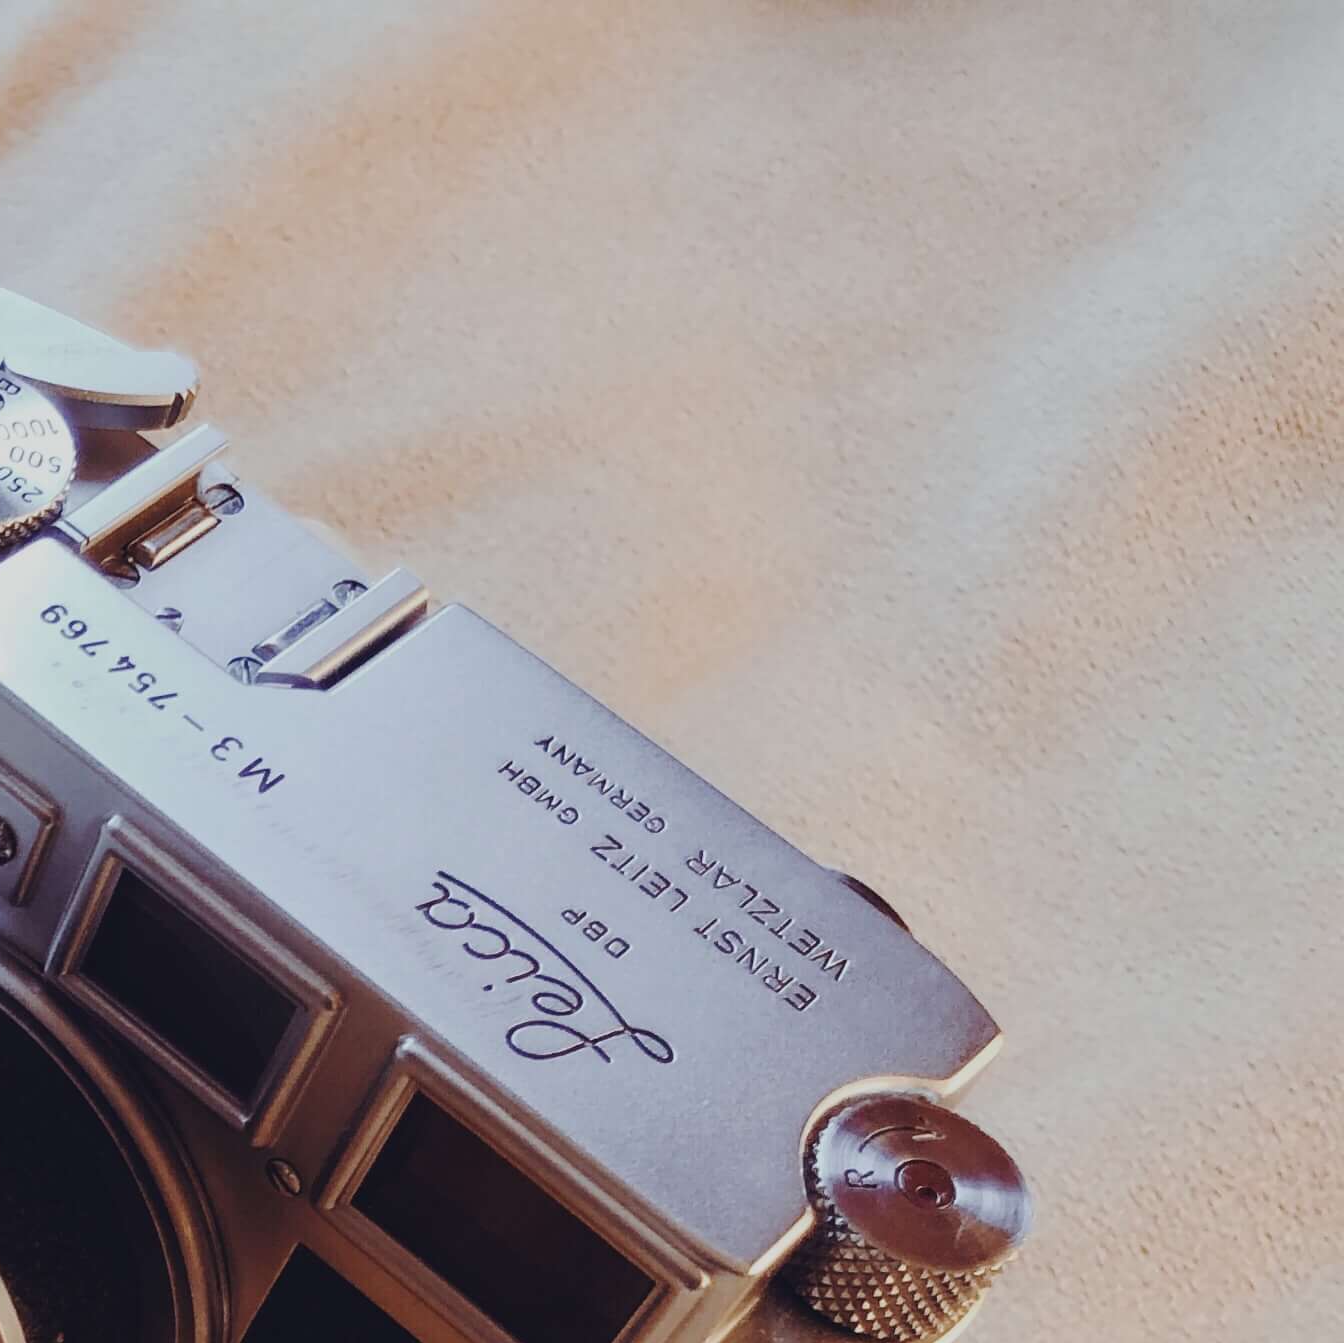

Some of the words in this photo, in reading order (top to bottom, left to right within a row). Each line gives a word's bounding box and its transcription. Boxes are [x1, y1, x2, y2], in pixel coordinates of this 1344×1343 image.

[9, 446, 62, 474] 500
[498, 760, 578, 824] GMBH
[534, 736, 666, 834] GERMANY
[591, 834, 688, 912] LEITZ
[561, 909, 629, 959] DBP
[686, 850, 850, 981] WETZLAR
[414, 870, 673, 1064] Leica
[694, 917, 816, 1012] ERNST
[844, 1168, 878, 1190] R
